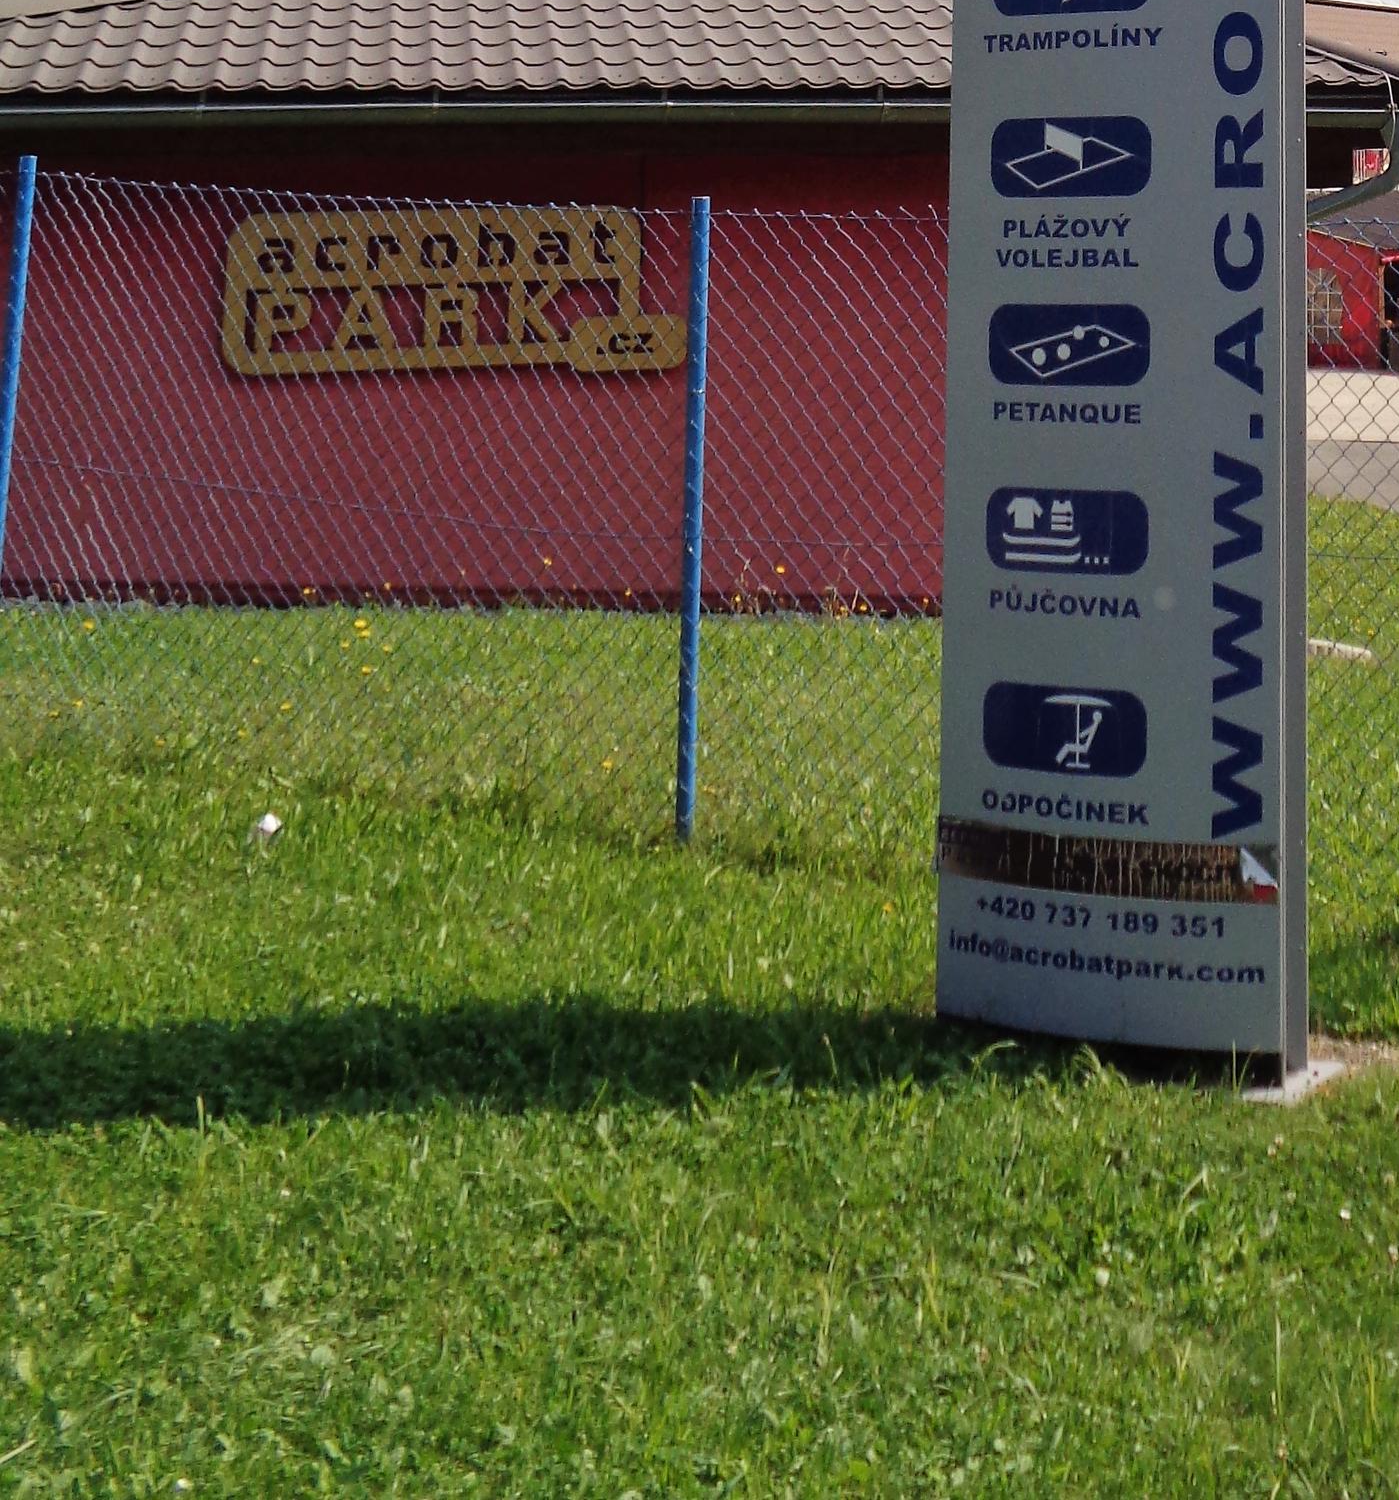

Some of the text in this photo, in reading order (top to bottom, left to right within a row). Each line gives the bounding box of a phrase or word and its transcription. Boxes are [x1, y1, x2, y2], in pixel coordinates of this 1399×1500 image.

[984, 23, 1164, 53] TRAMPOLÍNY
[1003, 213, 1132, 238] PLÁŽOVÝ
[257, 219, 617, 274] acrobat
[996, 248, 1139, 268] VOLEJBAL
[254, 283, 564, 353] PARK
[993, 401, 1141, 424] PETANQUE
[989, 584, 1142, 620] PŮJČOVNA
[977, 896, 1225, 938] +420 737 189 351
[949, 929, 1266, 984] info@acrobatpark.com
